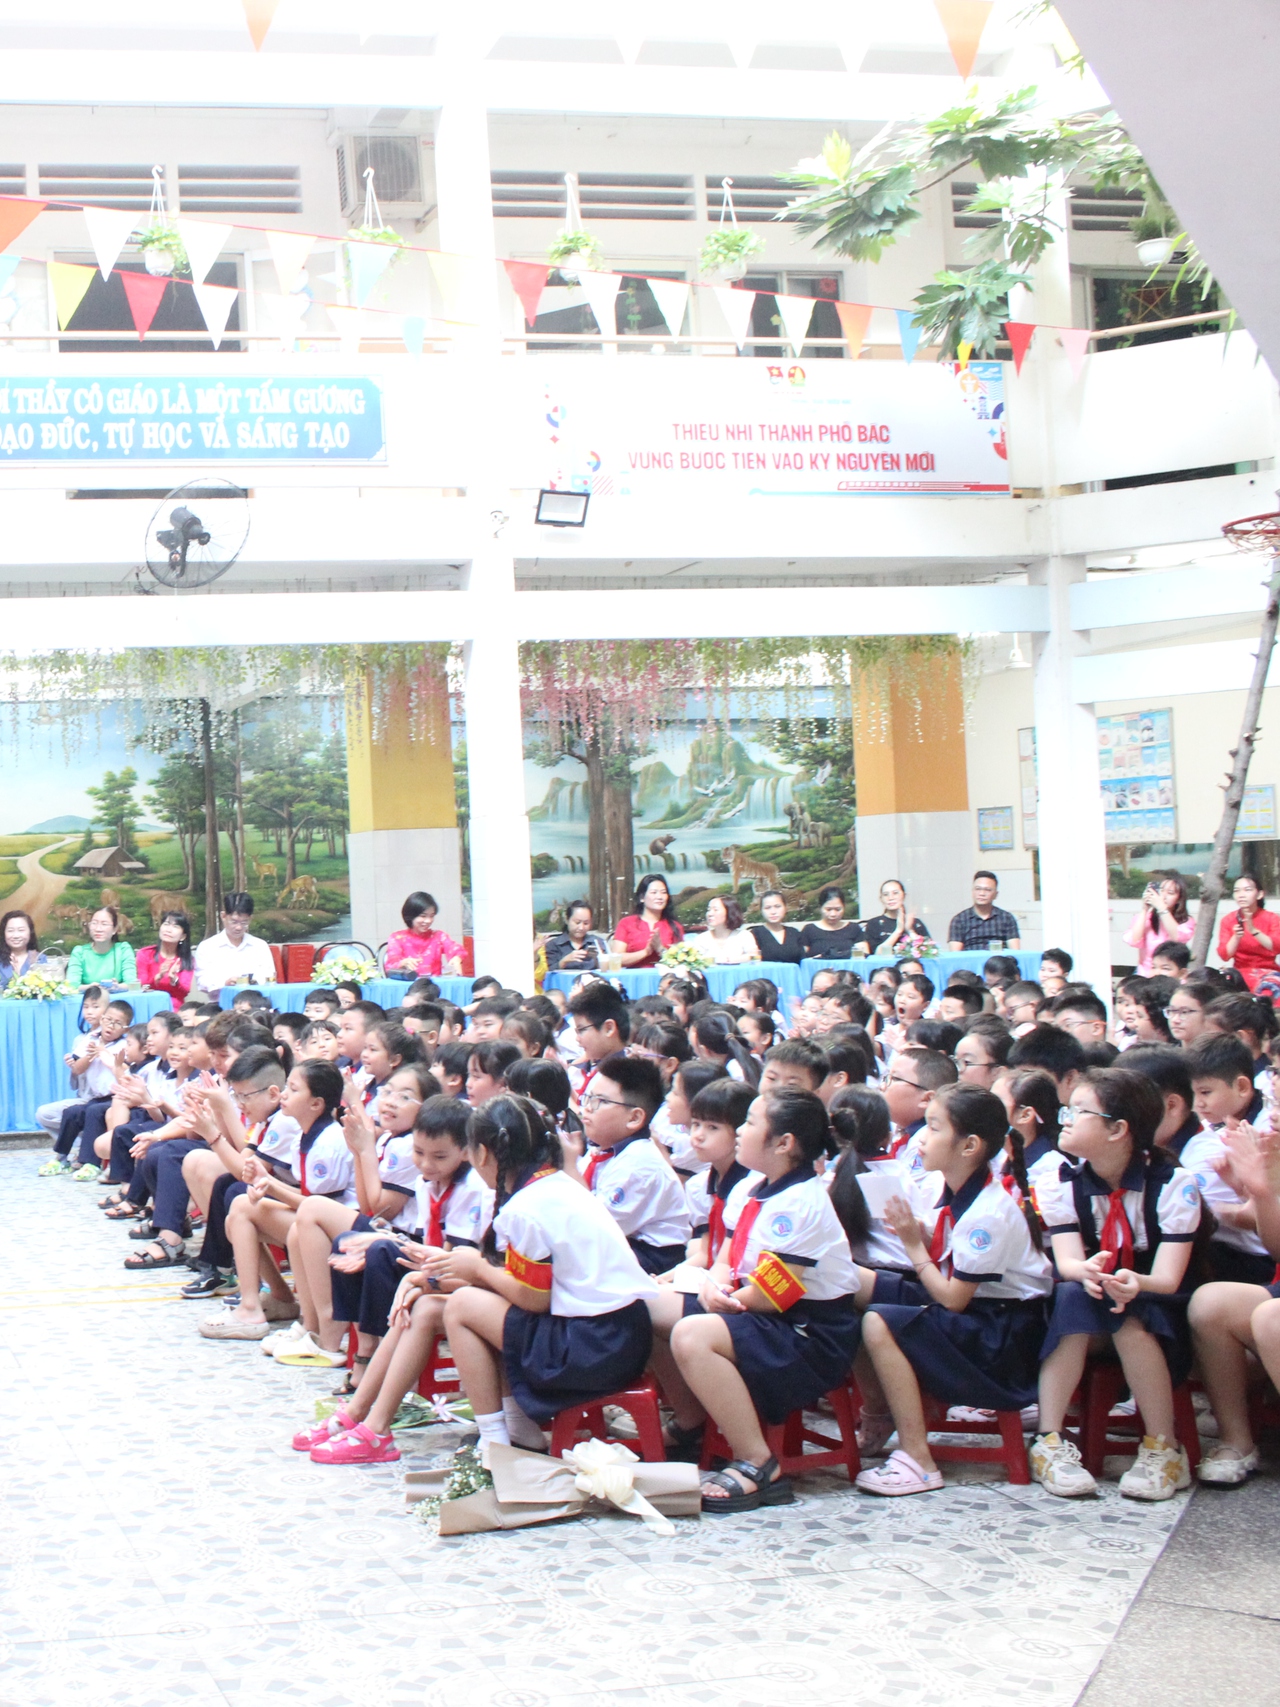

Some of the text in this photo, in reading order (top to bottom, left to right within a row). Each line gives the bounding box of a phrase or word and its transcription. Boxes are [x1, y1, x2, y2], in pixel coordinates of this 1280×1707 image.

[74, 382, 104, 414] CÔ
[107, 382, 158, 414] GIÁO
[161, 382, 192, 414] LÀ
[195, 382, 242, 419] MỘT
[245, 378, 291, 414] TẤM
[293, 384, 366, 415] GƯƠNG
[40, 416, 99, 453] ĐỨC,
[102, 417, 136, 456] TỰ
[142, 422, 193, 455] HỌC
[198, 415, 231, 448] VÀ
[236, 416, 299, 448] SÁNG
[304, 422, 351, 454] TẠO
[725, 423, 753, 442] NHI
